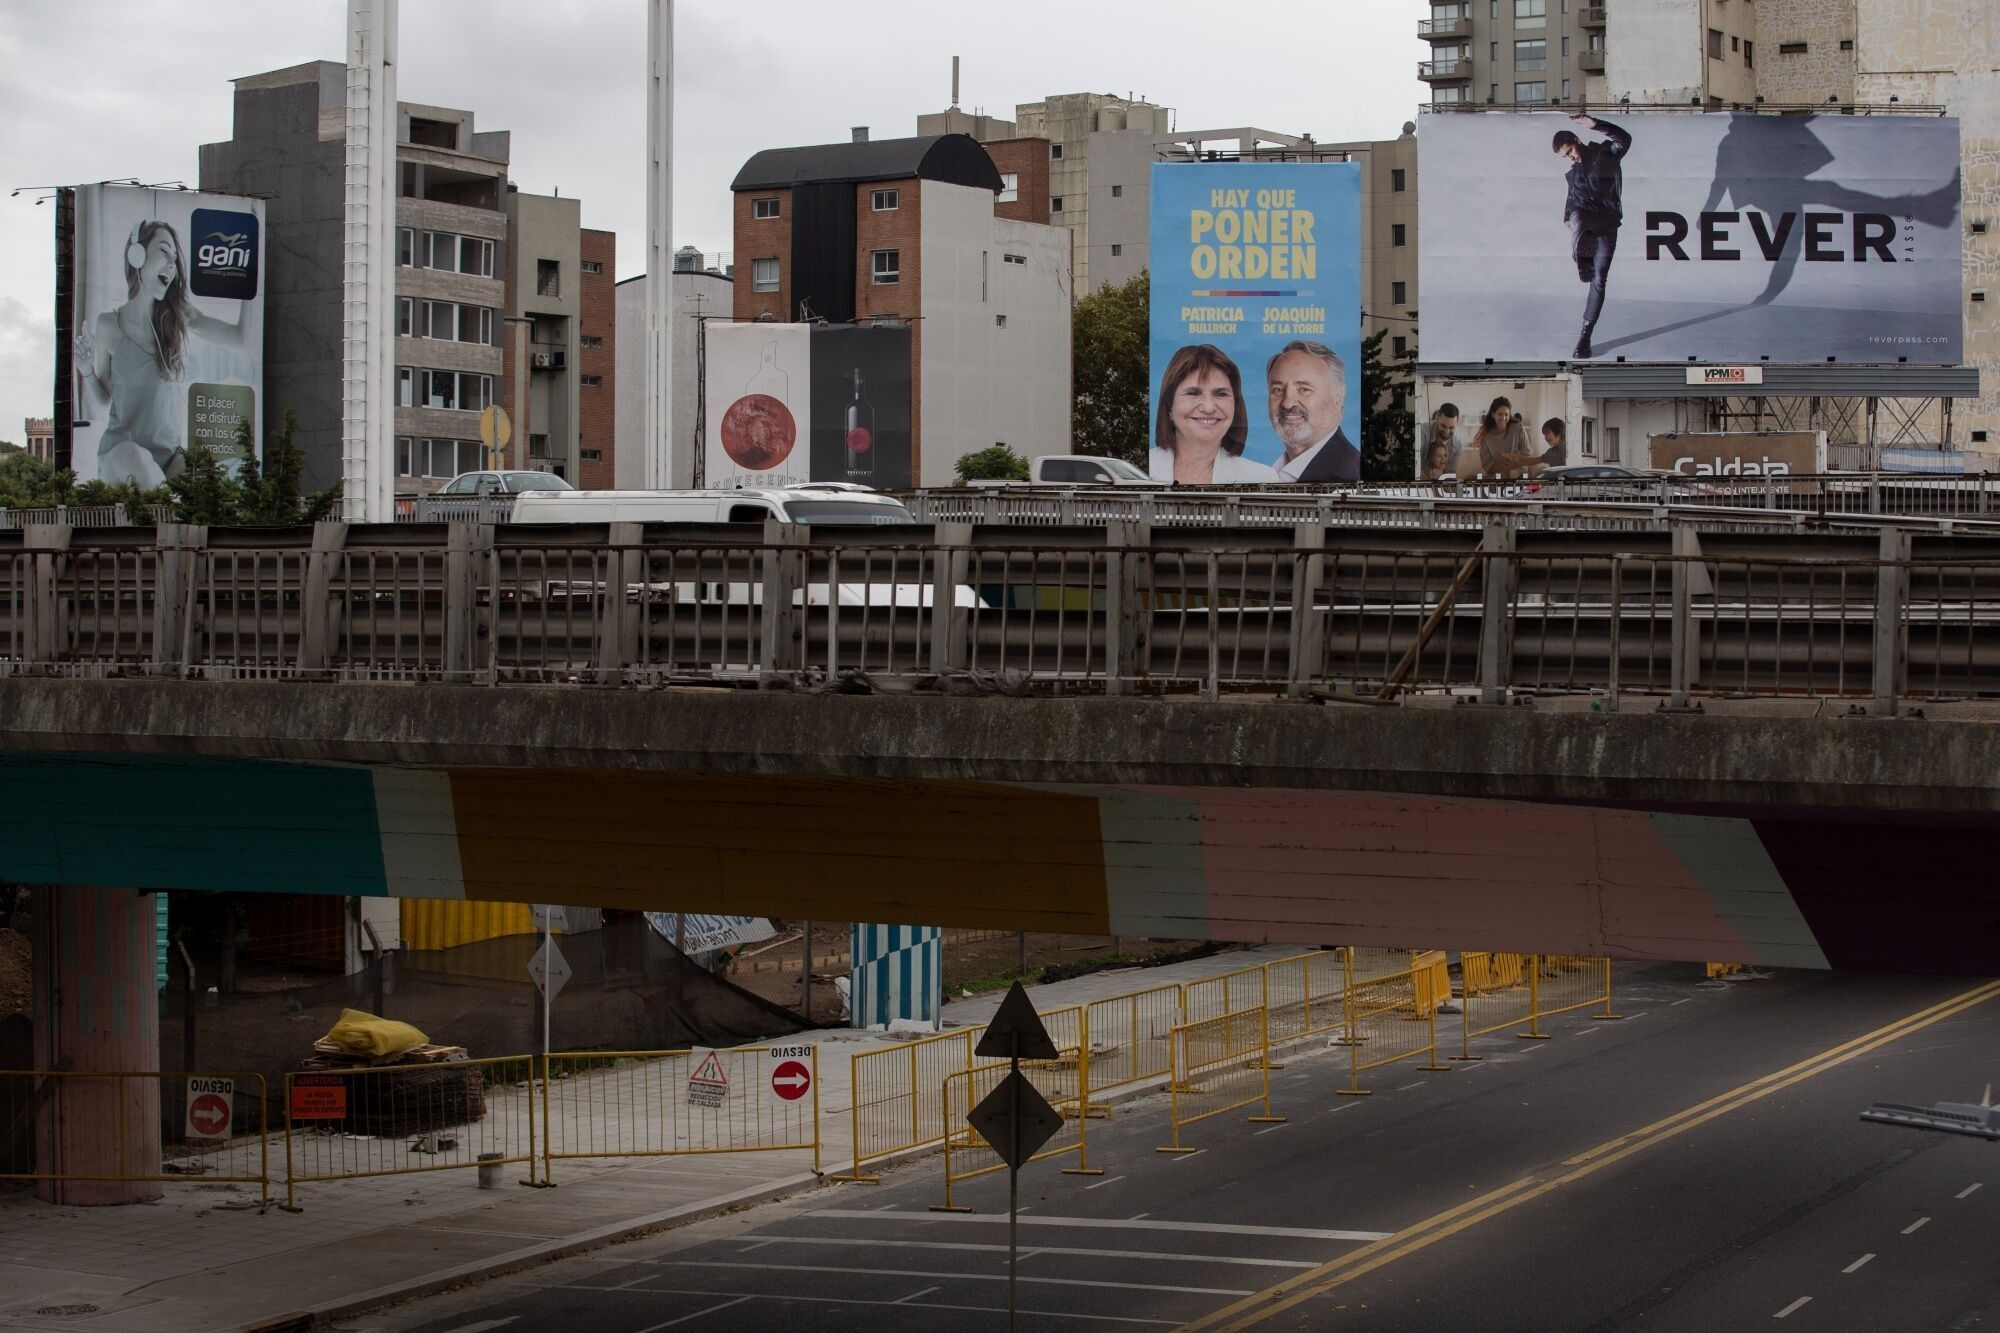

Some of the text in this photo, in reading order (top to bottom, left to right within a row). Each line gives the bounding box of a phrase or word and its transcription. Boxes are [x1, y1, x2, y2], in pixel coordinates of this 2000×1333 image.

[1211, 188, 1296, 210] HAY QUE
[1190, 209, 1316, 244] PONER
[1645, 211, 1898, 263] REVER
[197, 244, 251, 267] gani
[1190, 244, 1317, 280] ORDEN
[1181, 307, 1244, 321] PATRICIA
[1262, 304, 1325, 322] JOAQUÍN
[1189, 323, 1237, 334] BULLRICH
[1263, 323, 1325, 334] DE LA TORRE
[1869, 335, 1948, 344] reverpass.com
[1704, 368, 1730, 378] VPM
[196, 395, 235, 409] El placer
[196, 411, 241, 424] se disfruta
[196, 428, 213, 438] con
[215, 427, 229, 439] los
[771, 1046, 811, 1058] DESVIO
[190, 1079, 232, 1093] DESVIO
